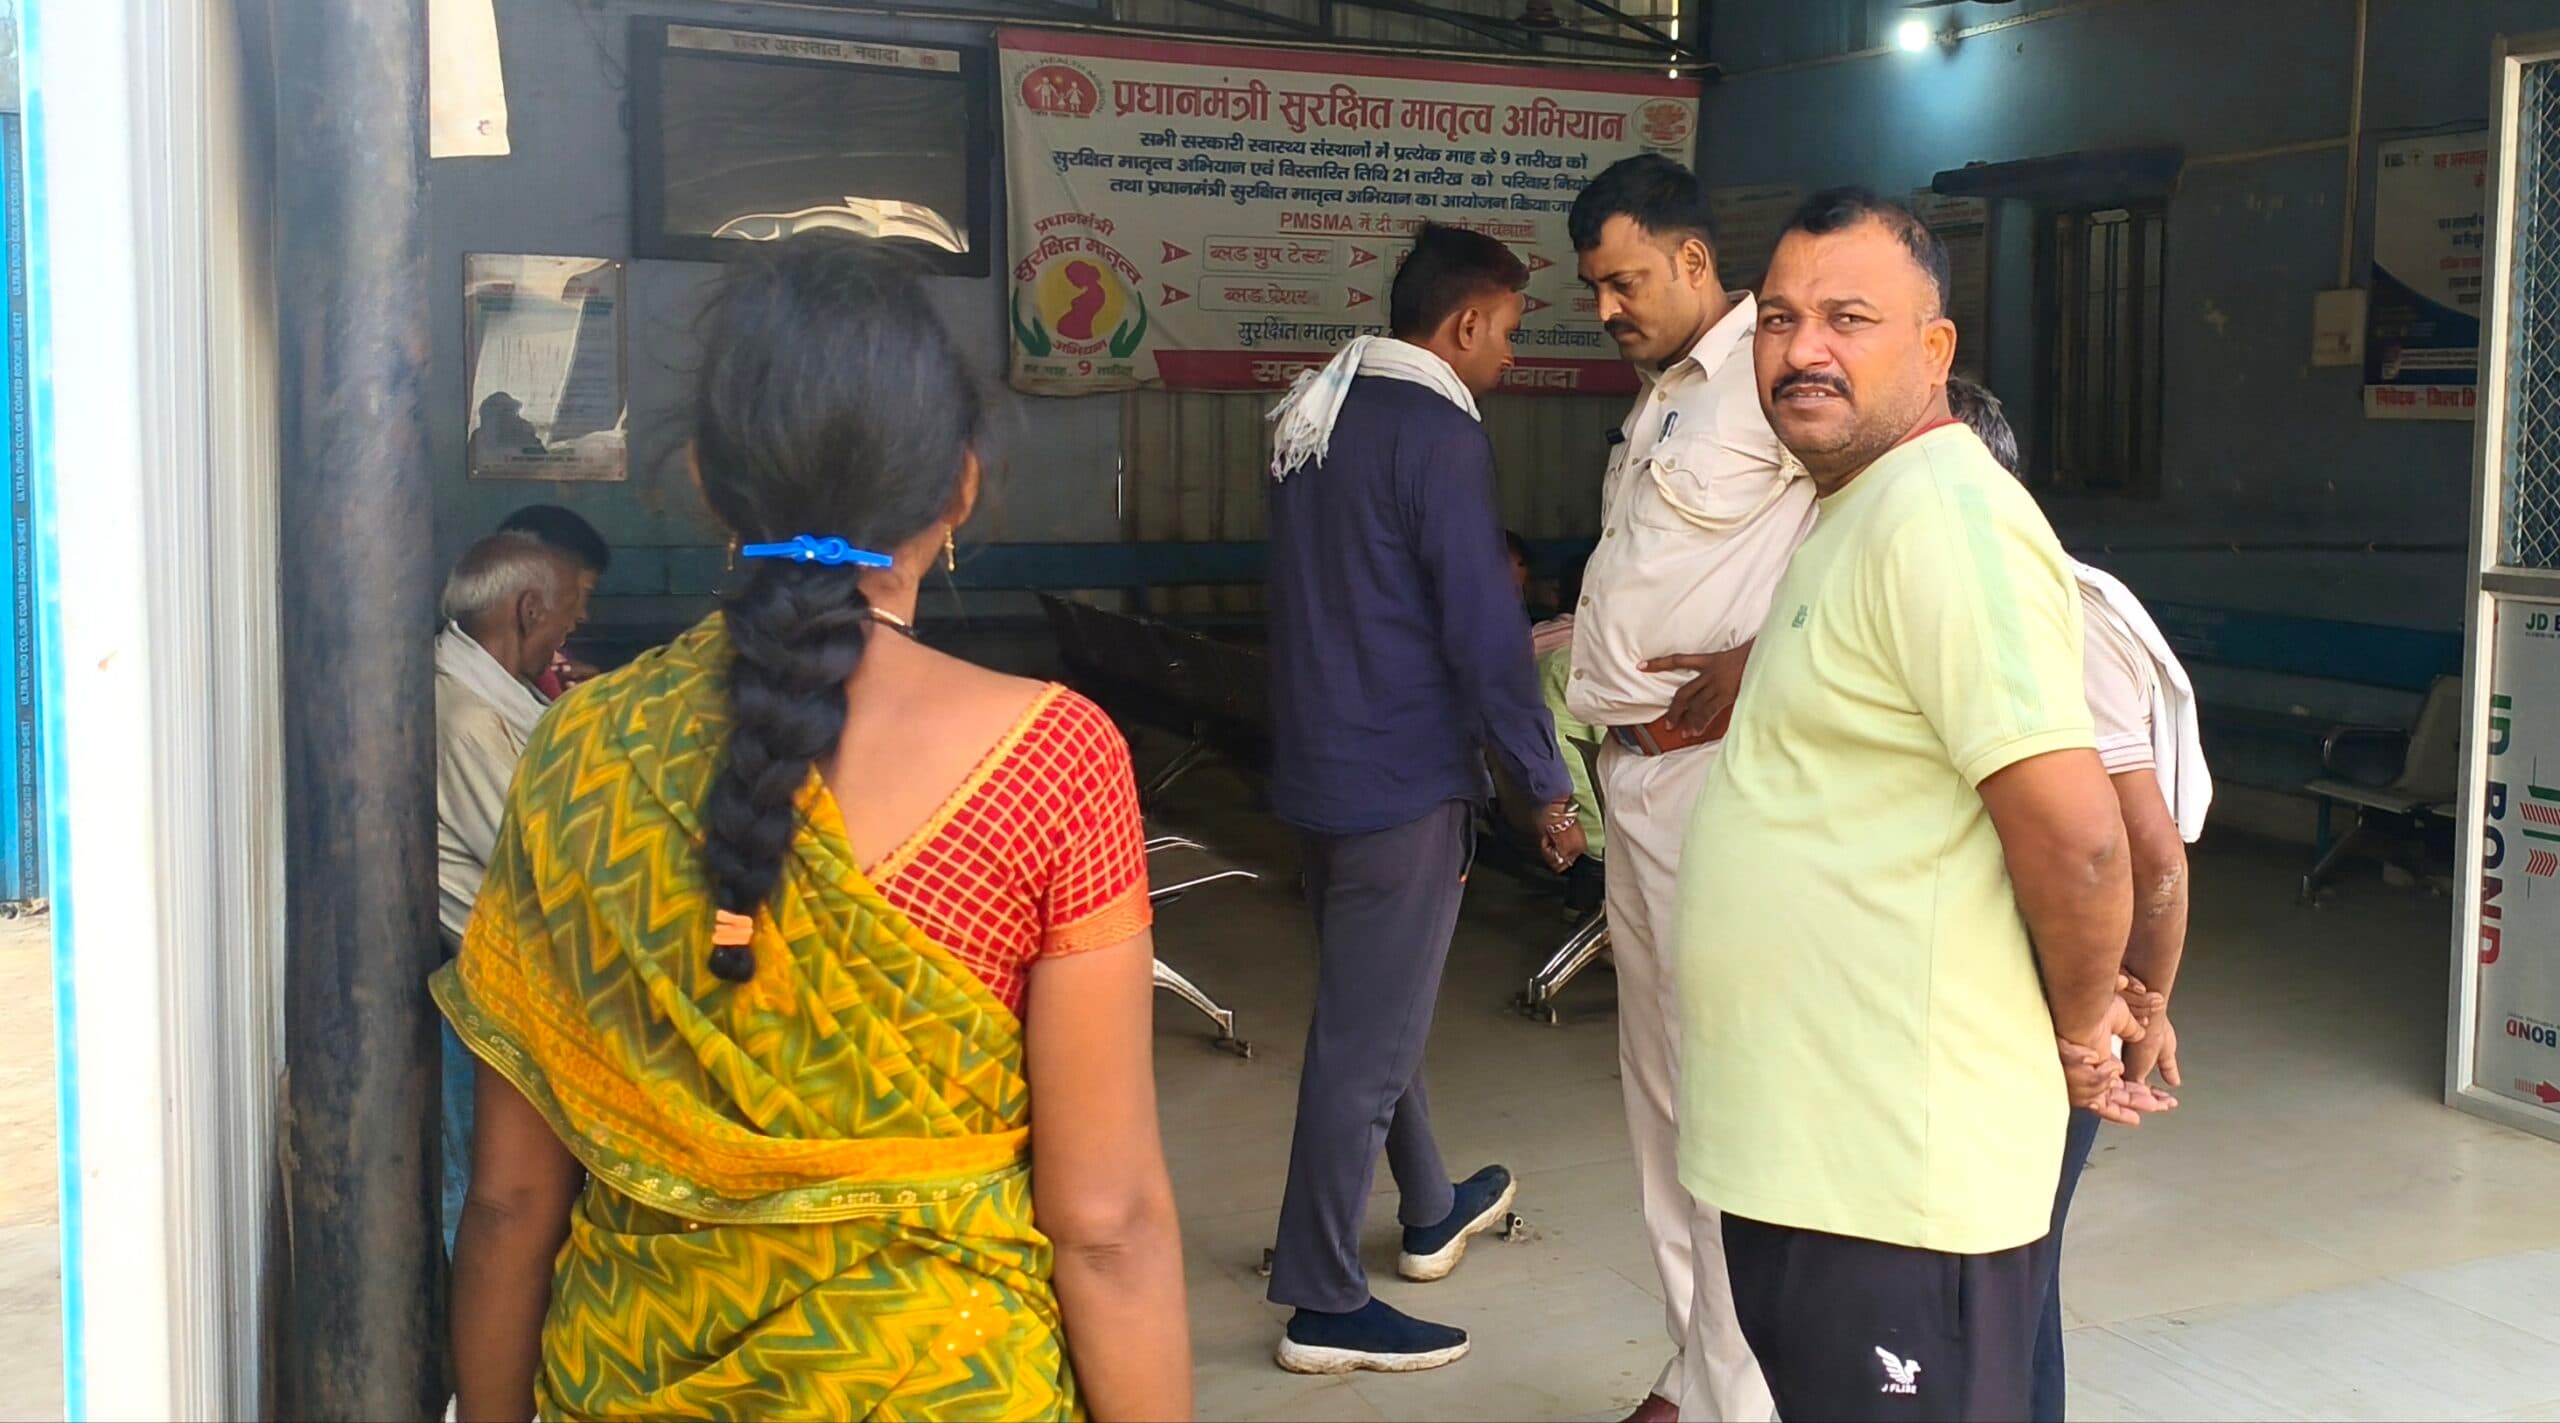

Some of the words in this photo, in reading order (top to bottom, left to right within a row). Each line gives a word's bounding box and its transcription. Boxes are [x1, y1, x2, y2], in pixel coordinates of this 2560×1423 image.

[1112, 76, 1271, 121] प्रधानमंत्री
[1279, 83, 1394, 133] सुरक्षित
[1401, 99, 1495, 142] मातृत्व
[1502, 97, 1627, 141] अभियान
[1140, 128, 1176, 148] सभी
[1181, 132, 1243, 151] सरकारी
[1248, 138, 1305, 155] स्वास्थ्य
[1310, 138, 1371, 158] संस्थानों
[1393, 144, 1441, 161] प्रत्येक
[1445, 149, 1475, 165] माह
[1480, 147, 1496, 164] के
[1500, 151, 1510, 165] 9
[1515, 149, 1562, 169] तारीख
[1566, 152, 1588, 169] को
[1053, 147, 1114, 172] सुरक्षित
[1118, 154, 1172, 175] मातृत्व
[1177, 154, 1245, 175] अभियान
[1251, 158, 1275, 176] एवं
[1279, 159, 1349, 181] विस्तारित
[1354, 162, 1389, 182] तिथि
[1393, 168, 1410, 183] 21
[1414, 166, 1464, 185] तारीख
[1471, 170, 1494, 187] को
[1502, 170, 1550, 190] परिवार
[1109, 178, 1142, 194] तथा
[1148, 179, 1226, 198] प्रधानमंत्री
[1230, 181, 1287, 204] सुरक्षित
[1292, 186, 1342, 207] मातृत्व
[1348, 186, 1410, 206] अभियान
[1415, 192, 1437, 207] का
[1441, 192, 1506, 210] आयोजन
[1511, 192, 1550, 212] किया
[1034, 212, 1115, 236] प्रधानमंत्री
[1280, 212, 1353, 231] PMSMA
[1358, 213, 1372, 231] में
[1376, 213, 1391, 233] दी
[1013, 235, 1082, 282] सुरक्षित
[1086, 237, 1143, 286] मातृत्व
[1210, 244, 1248, 262] ब्लड
[1254, 247, 1283, 270] ग्रुप
[1288, 242, 1329, 264] टेस्ट
[1224, 286, 1263, 303] ब्लड
[1238, 315, 1298, 347] सुरक्षित
[1303, 323, 1356, 347] मातृत्व
[1536, 324, 1603, 348] अधिकार
[1078, 360, 1092, 376] 9
[14, 379, 24, 412] COATED
[15, 414, 24, 448] COLOUR
[15, 450, 25, 473] DURO
[15, 475, 25, 501] ULTRA
[17, 545, 27, 582] ROOFING
[18, 585, 28, 617] COATED
[19, 618, 28, 652] COLOUR
[2526, 613, 2548, 631] JD
[20, 655, 29, 677] DURO
[20, 679, 29, 705] ULTRA
[23, 787, 32, 818] COATED
[24, 820, 32, 853] COLOUR
[2480, 782, 2508, 965] BOND
[2506, 1018, 2558, 1048] BOND
